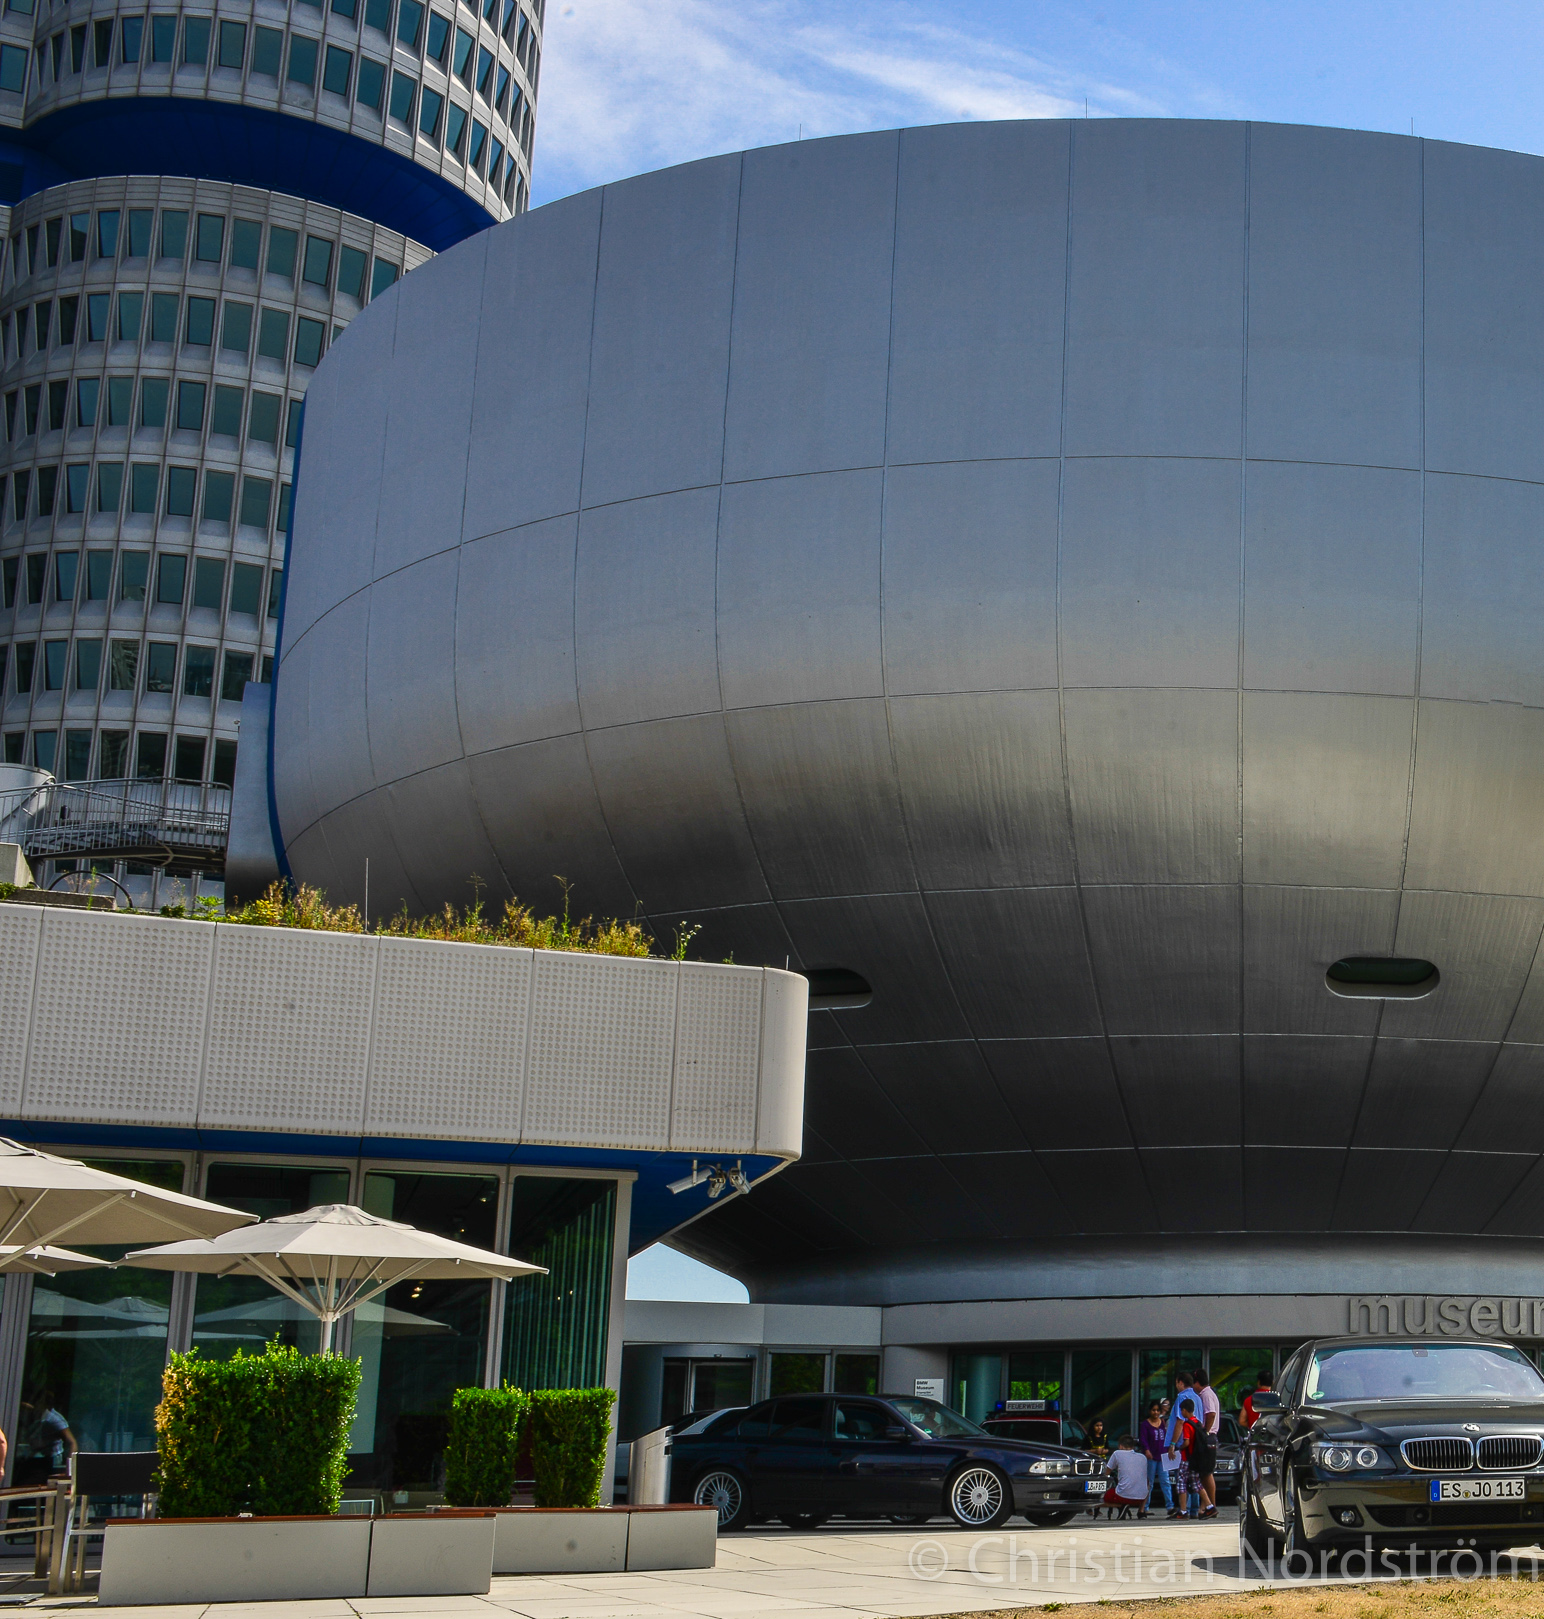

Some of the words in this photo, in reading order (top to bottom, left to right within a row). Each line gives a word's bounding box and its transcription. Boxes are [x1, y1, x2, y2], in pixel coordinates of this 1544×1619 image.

[1441, 1483, 1461, 1498] ES
[1472, 1482, 1491, 1497] JO
[1496, 1481, 1523, 1497] 113
